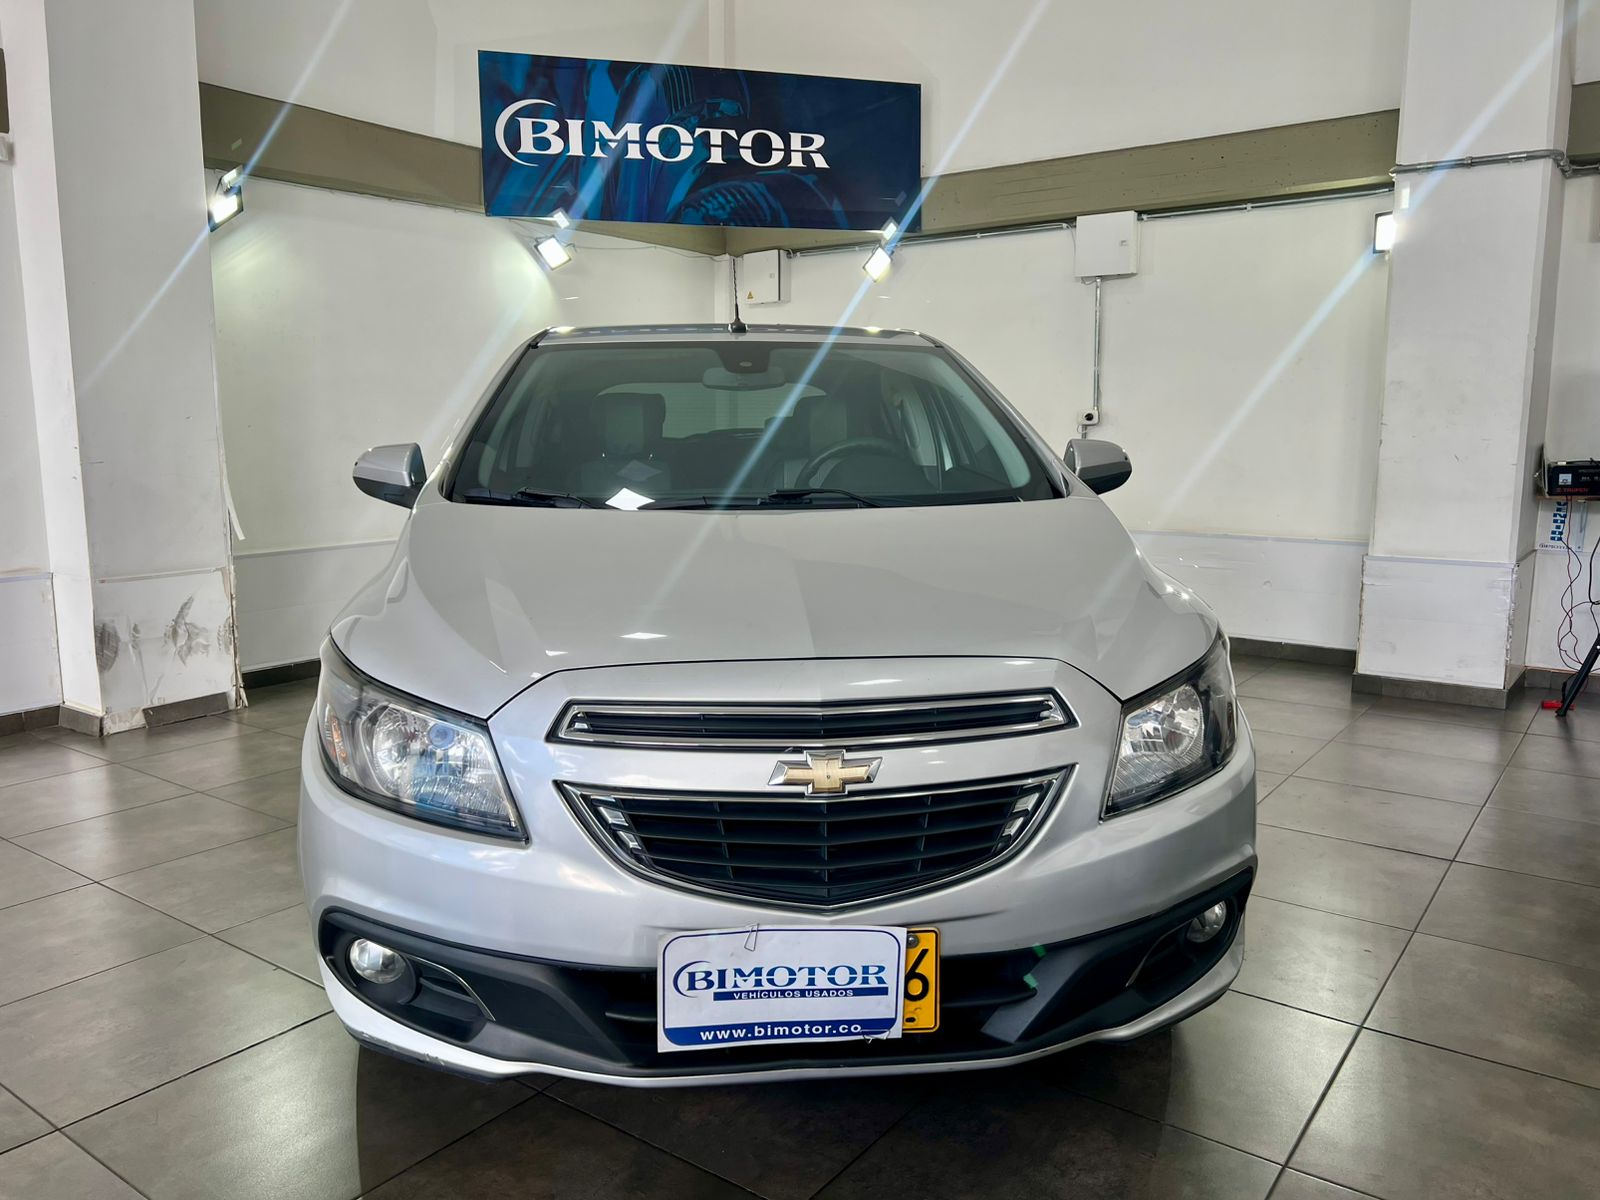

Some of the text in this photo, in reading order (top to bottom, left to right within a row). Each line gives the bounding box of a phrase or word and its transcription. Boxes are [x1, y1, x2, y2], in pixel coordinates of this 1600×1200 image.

[514, 115, 830, 169] BIMOTOR
[686, 964, 888, 991] BIMOTOR
[904, 948, 929, 1002] 6
[733, 989, 854, 1000] VEHÍCULOS USADOS
[700, 1022, 862, 1041] www.bimotor.co
